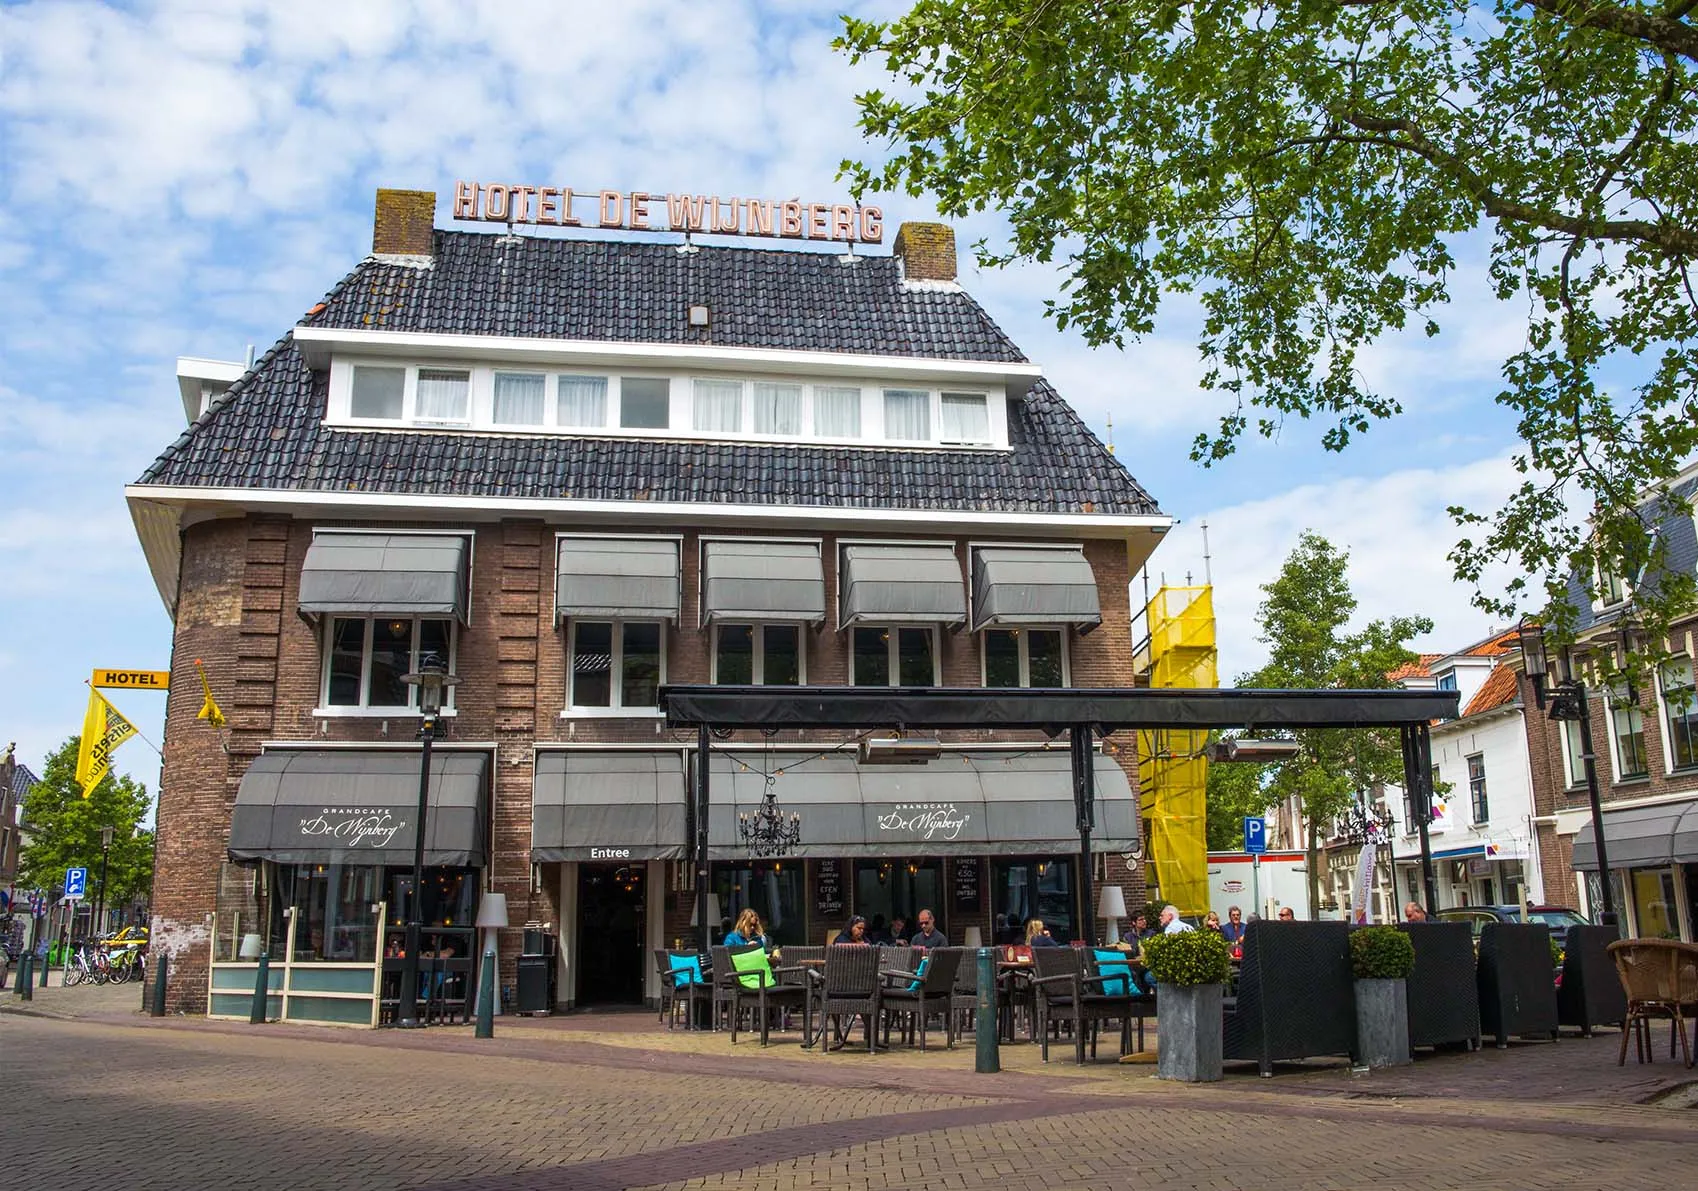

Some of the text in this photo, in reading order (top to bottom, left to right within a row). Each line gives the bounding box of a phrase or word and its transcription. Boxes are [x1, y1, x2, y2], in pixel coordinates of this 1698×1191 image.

[454, 181, 882, 243] HOTEL DE WIJNBERG
[105, 672, 158, 685] HOTEL
[1249, 820, 1261, 839] P
[591, 848, 630, 859] Entree
[71, 871, 82, 884] P
